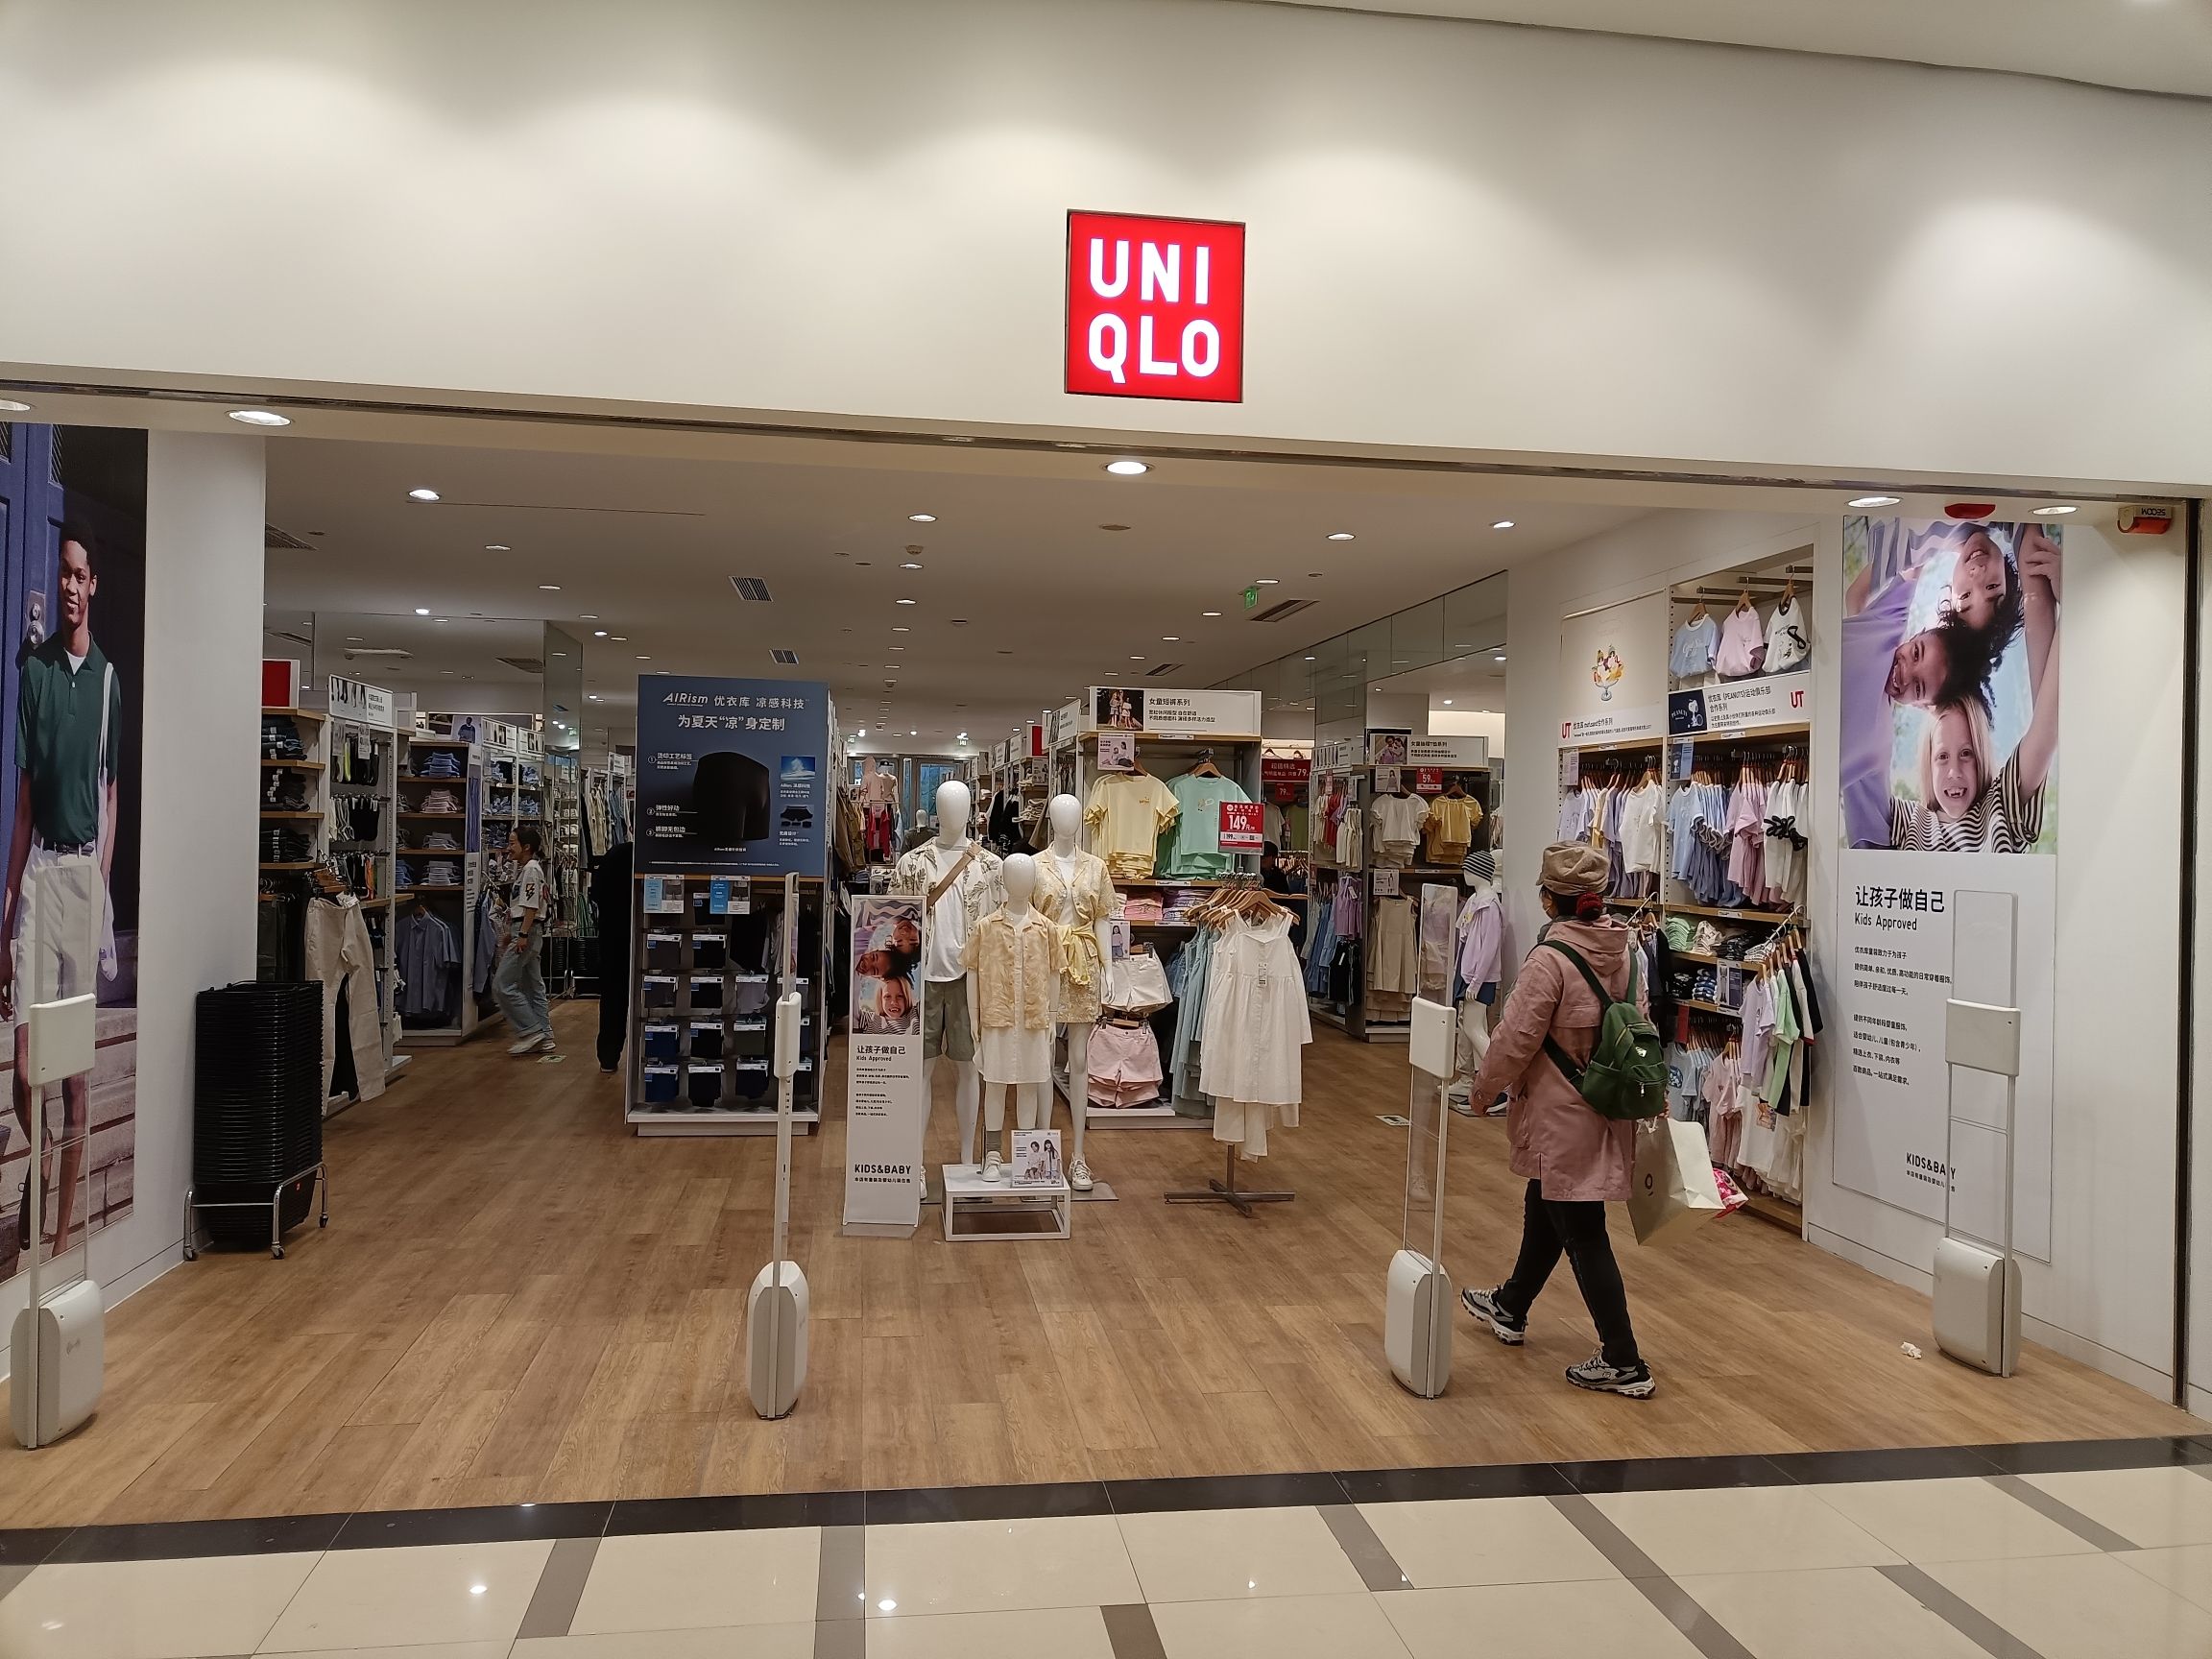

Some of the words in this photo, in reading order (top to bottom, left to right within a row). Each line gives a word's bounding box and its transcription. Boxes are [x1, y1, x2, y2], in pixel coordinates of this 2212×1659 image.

[1090, 238, 1210, 305] UNI
[1088, 312, 1220, 384] QLO
[2141, 507, 2166, 517] SECOM
[661, 692, 709, 704] AIRism
[713, 695, 751, 708] 优衣库
[756, 697, 805, 709] 凉感科技
[1148, 697, 1191, 707] 女童短裤系列
[1791, 690, 1804, 708] UT
[1561, 722, 1572, 739] UT
[1855, 885, 1945, 913] 让孩子做自己
[1854, 912, 1872, 926] Kids
[1875, 914, 1917, 931] Approved
[1854, 946, 1908, 960] 优衣库童装致力于为孩子
[856, 1045, 906, 1055] 让孩子做自己
[854, 1164, 911, 1175] KIDS&BABY
[1906, 1152, 1956, 1180] KIDS&BAY
